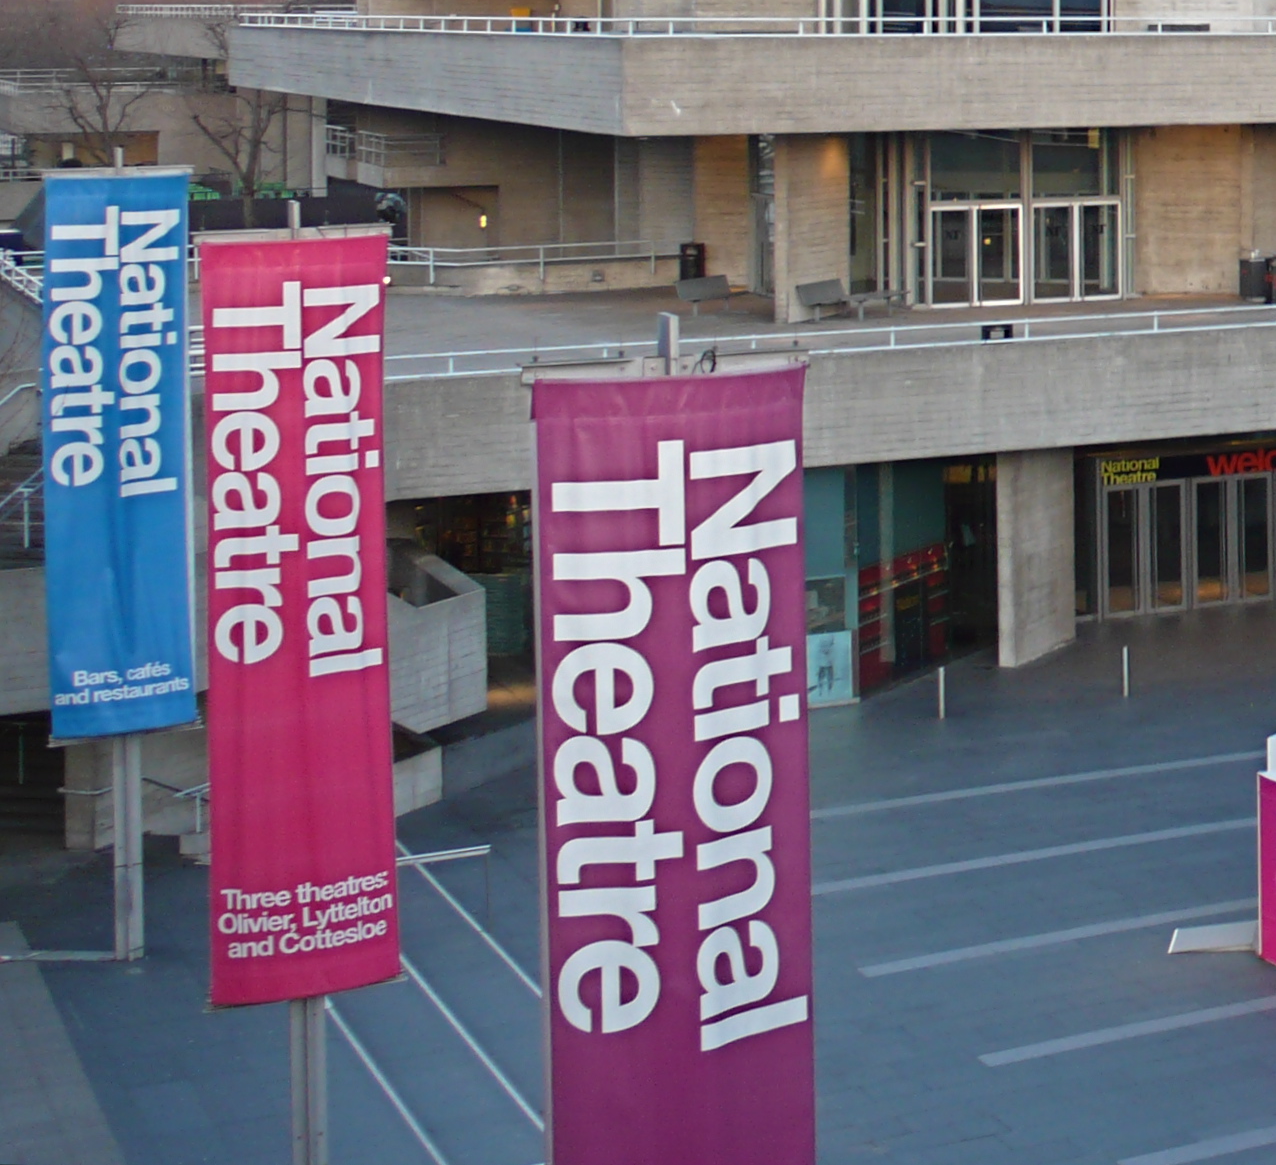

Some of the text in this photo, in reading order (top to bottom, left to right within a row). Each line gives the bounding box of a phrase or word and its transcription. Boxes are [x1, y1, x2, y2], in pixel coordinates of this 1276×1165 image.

[49, 204, 119, 487] Theatre
[118, 206, 179, 498] National
[211, 279, 303, 666] Theatre
[302, 282, 383, 678] National
[1101, 456, 1160, 473] National
[1101, 471, 1157, 486] Theatre
[54, 677, 189, 705] and restaurants
[73, 661, 171, 686] Bars, cafés
[550, 438, 687, 1034] Theatre
[688, 438, 809, 1053] National
[220, 871, 388, 910] Three theatres:
[218, 893, 393, 935] Olivier, Lyttelton
[228, 919, 387, 959] and Cottesloe
